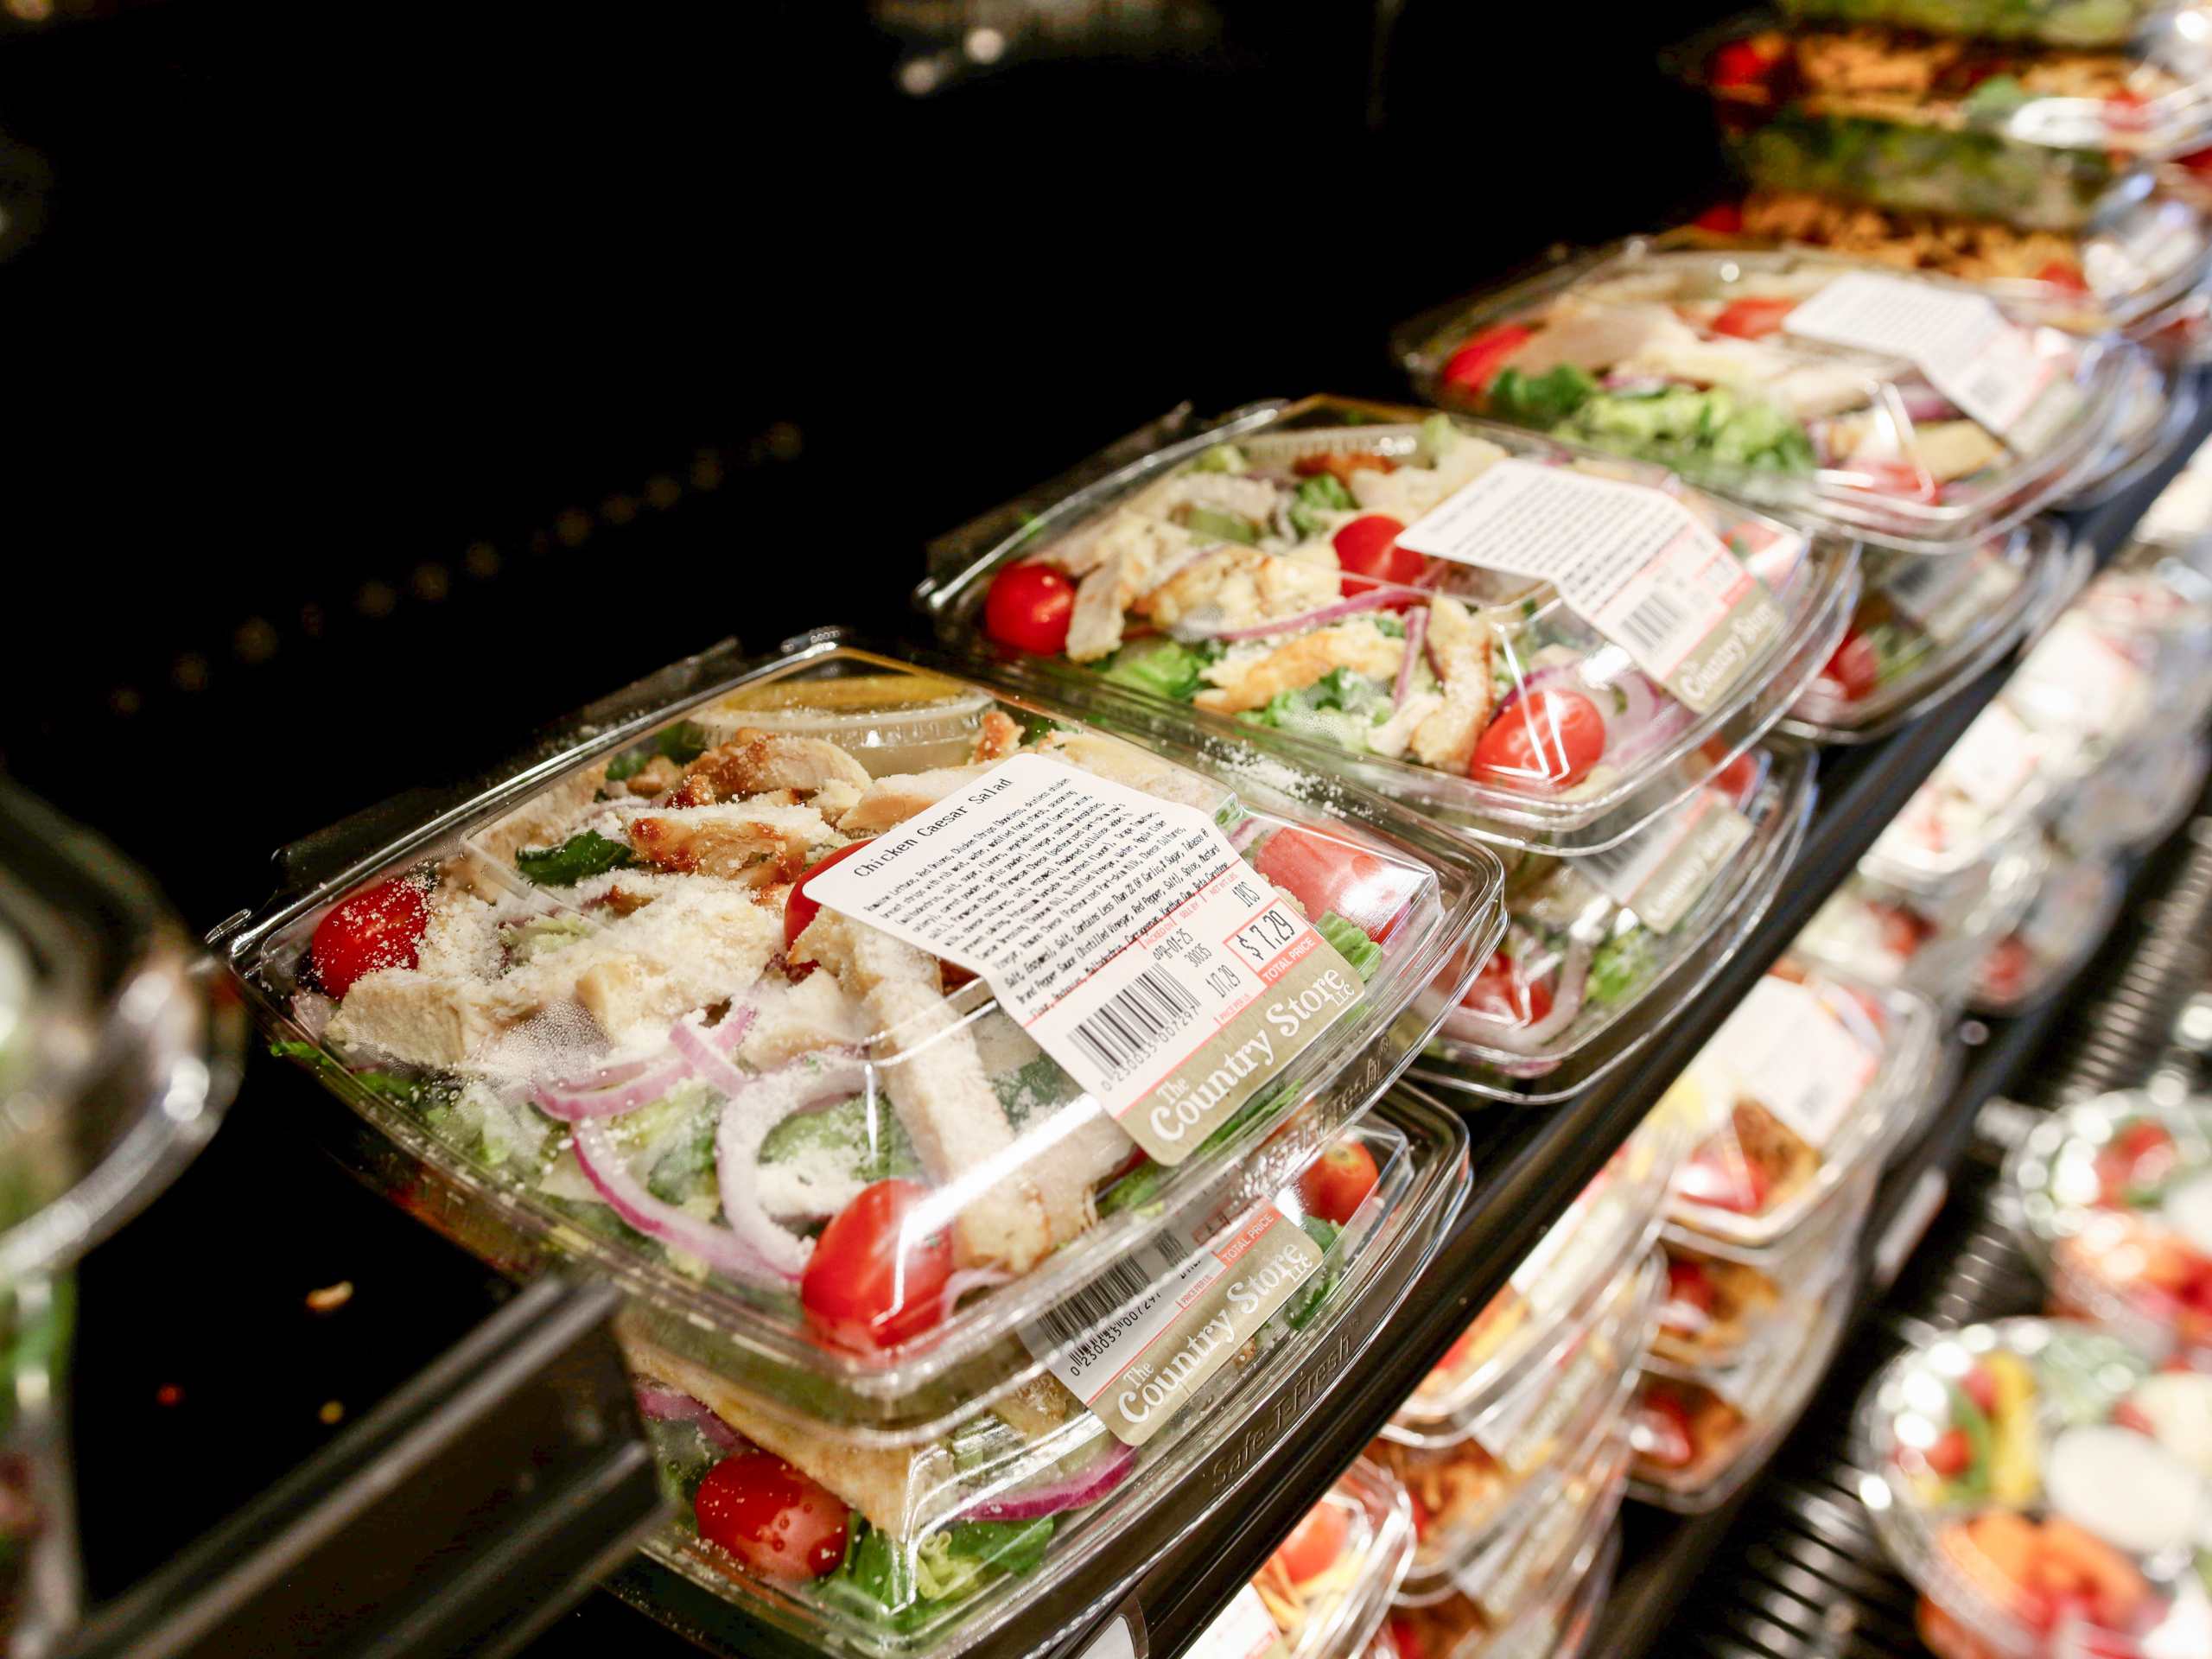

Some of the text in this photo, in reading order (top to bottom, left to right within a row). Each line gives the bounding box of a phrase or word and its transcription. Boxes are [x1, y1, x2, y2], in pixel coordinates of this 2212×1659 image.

[854, 779, 1013, 876] Chicken Caesar Salad
[915, 868, 931, 878] Red
[927, 855, 955, 869] Onions,
[950, 839, 977, 855] Chicken
[973, 826, 997, 840] Strips
[993, 809, 1027, 826] (Boneless,
[1025, 791, 1050, 808] skinless
[1048, 778, 1071, 792] chicken
[943, 883, 963, 895] salt,
[961, 870, 982, 882] sugar,
[978, 853, 1008, 868] flavors,
[1007, 833, 1034, 851] vegetable
[1033, 822, 1050, 834] stock
[1046, 807, 1075, 822] (carrot,
[1073, 796, 1093, 806] onion,
[880, 791, 1077, 919] breast strips with rib meat, water, modified food starch, seasoning
[940, 898, 961, 913] carrot
[961, 884, 986, 899] powder,
[984, 868, 1006, 884] garlic
[1004, 853, 1031, 870] powder),
[1029, 836, 1056, 852] vinegar,
[1053, 823, 1074, 836] sodium
[1072, 803, 1105, 823] phosphates,
[944, 935, 964, 947] milk,
[963, 918, 984, 933] cheese
[984, 899, 1014, 918] cultures,
[1013, 887, 1033, 899] salt,
[1030, 868, 1060, 886] enzymes),
[1055, 848, 1084, 867] Powdered
[1079, 827, 1109, 849] Cellulose
[1109, 817, 1126, 828] added
[950, 904, 980, 921] Parmesan
[977, 889, 1001, 904] Cheese
[998, 869, 1029, 887] (Parmesan
[1026, 855, 1049, 870] Cheese
[1045, 830, 1084, 856] (pasteurized
[1082, 813, 1110, 831] part-skim
[1039, 917, 1063, 933] Cheese
[1060, 889, 1101, 915] (Pasteurized
[1096, 870, 1128, 891] Part-skim
[1122, 860, 1144, 871] Milk,
[1138, 844, 1160, 860] Cheese
[1156, 827, 1186, 846] Cultures,
[961, 935, 984, 954] prevent
[986, 919, 1011, 935] caking,
[1007, 899, 1040, 918] Potassium
[1035, 881, 1062, 899] Sorbate
[1068, 860, 1090, 876] protect
[1114, 827, 1134, 839] Grape
[1129, 812, 1160, 827] Tomatoes,
[976, 820, 1166, 960] Caesar Dressing (Soybean Oil, Distilled Vinegar, Water, Apple Cider
[1159, 899, 1183, 916] Xanthan
[1179, 890, 1196, 901] Gum,
[1192, 879, 1208, 892] Beta
[1205, 862, 1229, 881] Carotene
[1179, 900, 1199, 919] SELL BY
[1209, 884, 1221, 896] NET
[1232, 881, 1260, 908] 1PCS
[1004, 971, 1026, 988] Salt,
[1054, 933, 1074, 950] Salt,
[1072, 912, 1100, 936] Contains
[1097, 902, 1115, 916] Less
[1111, 892, 1128, 905] Than
[1124, 882, 1136, 895] 2%
[1133, 877, 1143, 889] Of
[1164, 851, 1185, 865] Sugar,
[1181, 835, 1204, 851] Tabasco
[1015, 843, 1220, 1004] Brand Pepper Sauce (Distilled Vinegar, Red Pepper, Salt), Spice, Mustard
[1144, 921, 1174, 946] PACKED ON
[1249, 910, 1294, 950] 7.29
[1184, 943, 1212, 968] 30035
[1262, 937, 1315, 982] TOTAL PRICE
[1219, 1005, 1235, 1020] PRICE
[1231, 999, 1243, 1011] PER
[1332, 983, 1355, 1008] LLC
[1149, 1029, 1274, 1142] Country
[1266, 968, 1345, 1038] Store
[1155, 1077, 1190, 1105] The
[1223, 1236, 1249, 1263] TOTAL
[1247, 1213, 1274, 1240] PRICE
[1180, 1287, 1197, 1306] PRICE
[1194, 1281, 1205, 1293] PER
[1289, 1256, 1313, 1283] LLC
[1070, 1365, 1080, 1377] 0
[1081, 1324, 1122, 1368] 230035
[1118, 1243, 1305, 1423] Country Store
[1123, 1361, 1154, 1389] The
[1213, 1334, 1351, 1488] Safe-T-Fresh
